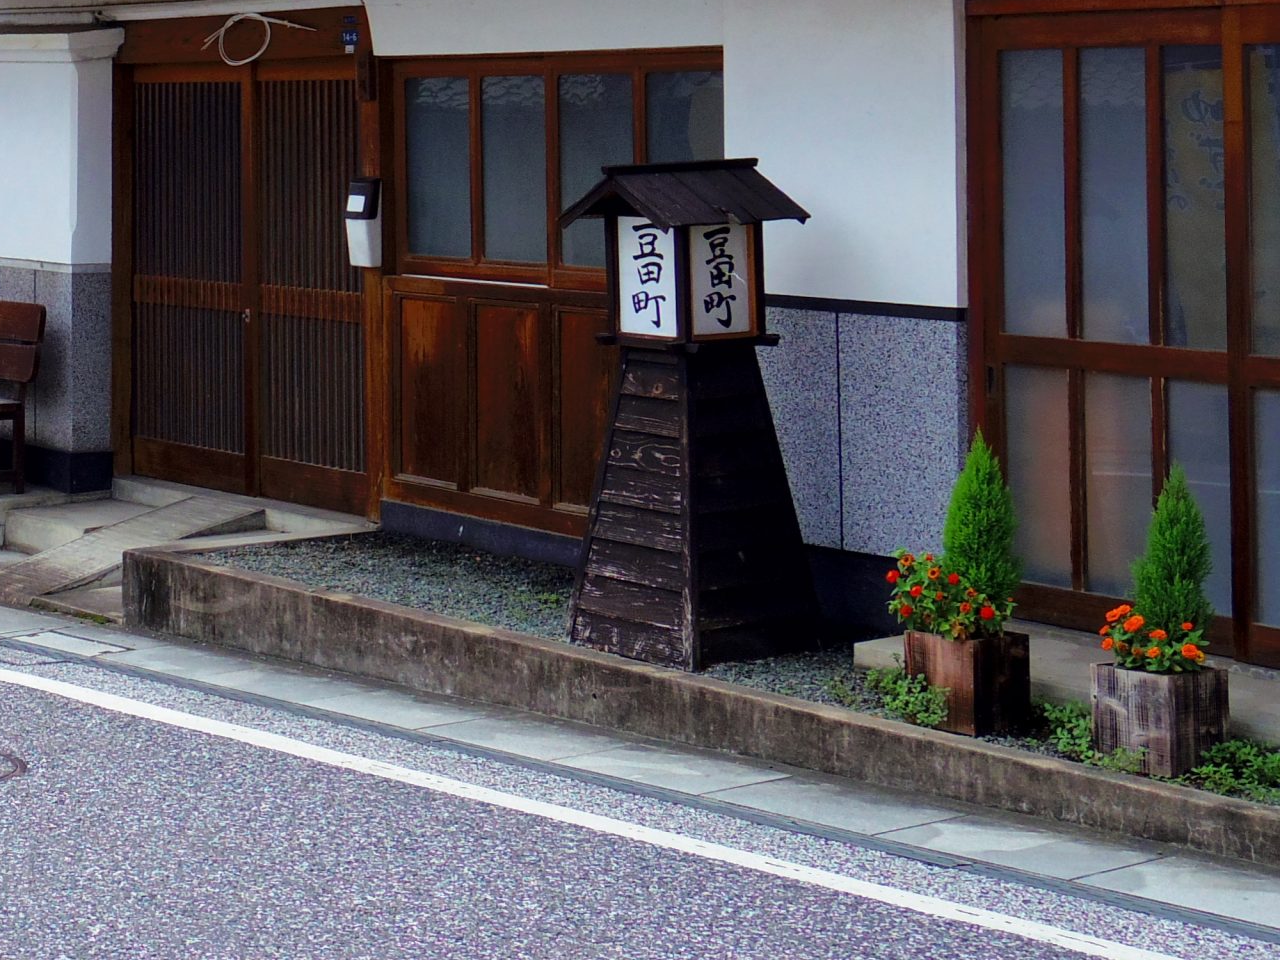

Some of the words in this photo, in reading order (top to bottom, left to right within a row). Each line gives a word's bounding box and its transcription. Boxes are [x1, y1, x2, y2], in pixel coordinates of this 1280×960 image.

[632, 223, 666, 328] 豆田町
[703, 226, 736, 328] 豆田町
